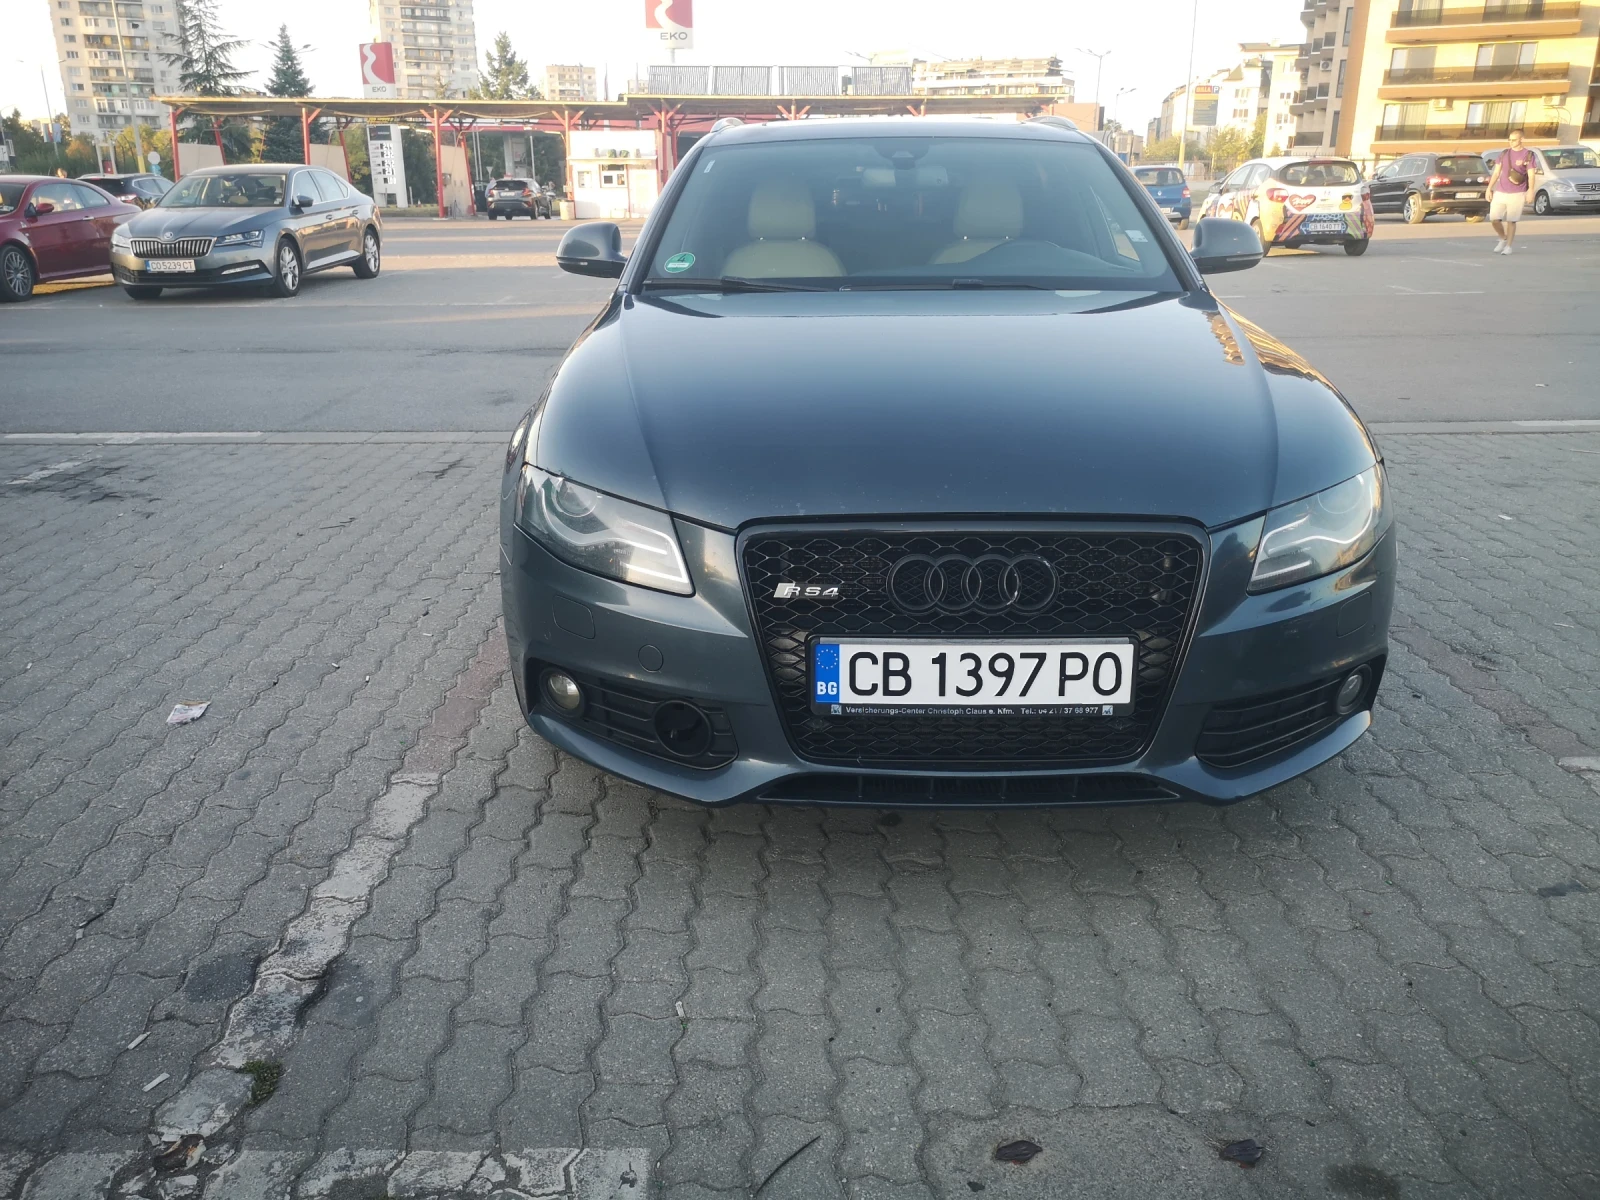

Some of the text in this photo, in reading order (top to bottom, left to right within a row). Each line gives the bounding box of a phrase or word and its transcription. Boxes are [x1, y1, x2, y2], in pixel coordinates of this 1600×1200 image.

[660, 32, 688, 40] EKO
[677, 253, 687, 263] 4
[162, 261, 182, 270] 5239
[183, 261, 193, 270] CT
[782, 586, 840, 598] RS4
[849, 651, 912, 697] CB
[931, 652, 1048, 697] 1397
[816, 682, 838, 695] BG
[845, 706, 925, 715] Versicherungs-Center
[927, 707, 964, 715] Christoph
[965, 707, 987, 715] Claus
[997, 707, 1015, 715] Kfm.
[1020, 707, 1037, 715] Tel.:
[1063, 706, 1073, 714] 37
[1085, 706, 1099, 714] 977
